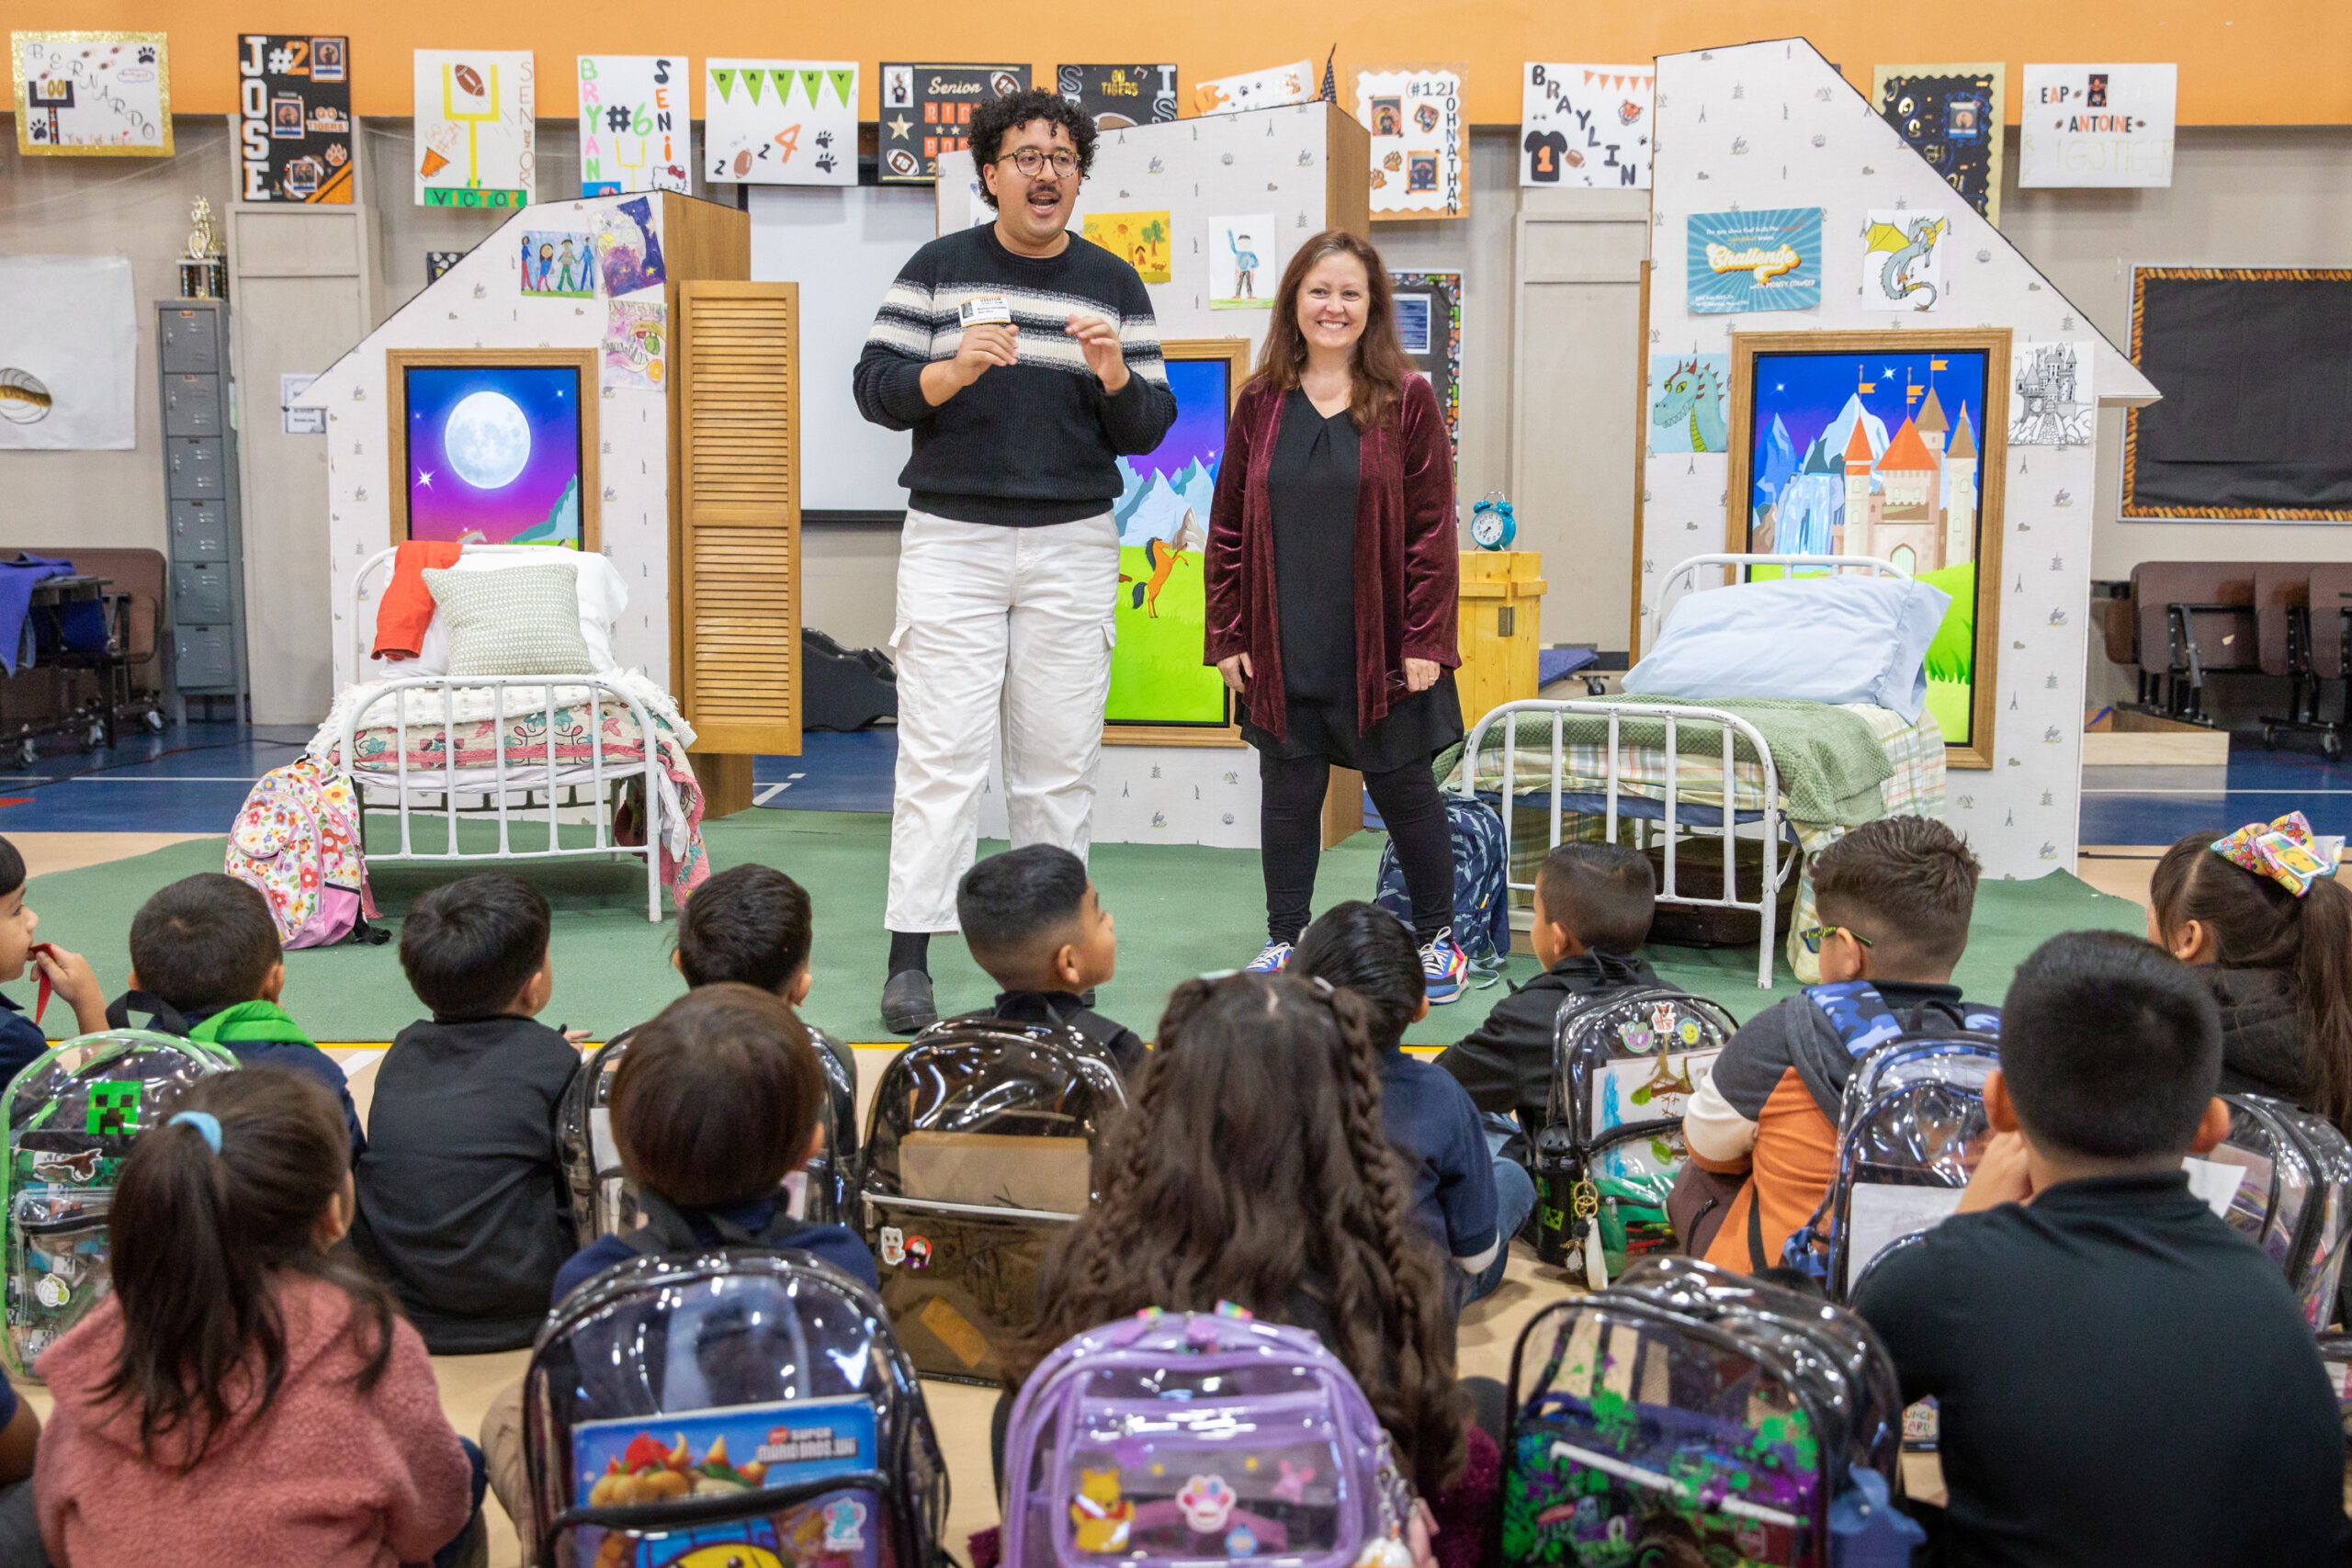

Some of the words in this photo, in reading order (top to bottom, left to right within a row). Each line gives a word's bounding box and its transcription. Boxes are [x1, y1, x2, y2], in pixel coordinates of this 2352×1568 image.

[268, 40, 310, 75] #2
[928, 76, 983, 95] Senior
[1101, 82, 1138, 96] TIGERS
[1111, 69, 1126, 83] GO
[241, 36, 271, 200] JOSE
[316, 107, 337, 119] GO
[581, 58, 603, 181] BRYAN
[606, 102, 653, 137] #6
[1532, 65, 1635, 186] BRAYLIN
[2068, 115, 2132, 133] ANTOINE
[1446, 81, 1457, 216] JOHNATHAN
[1537, 145, 1553, 172] 1
[434, 190, 519, 208] VICTOR
[1706, 243, 1802, 283] Challenge
